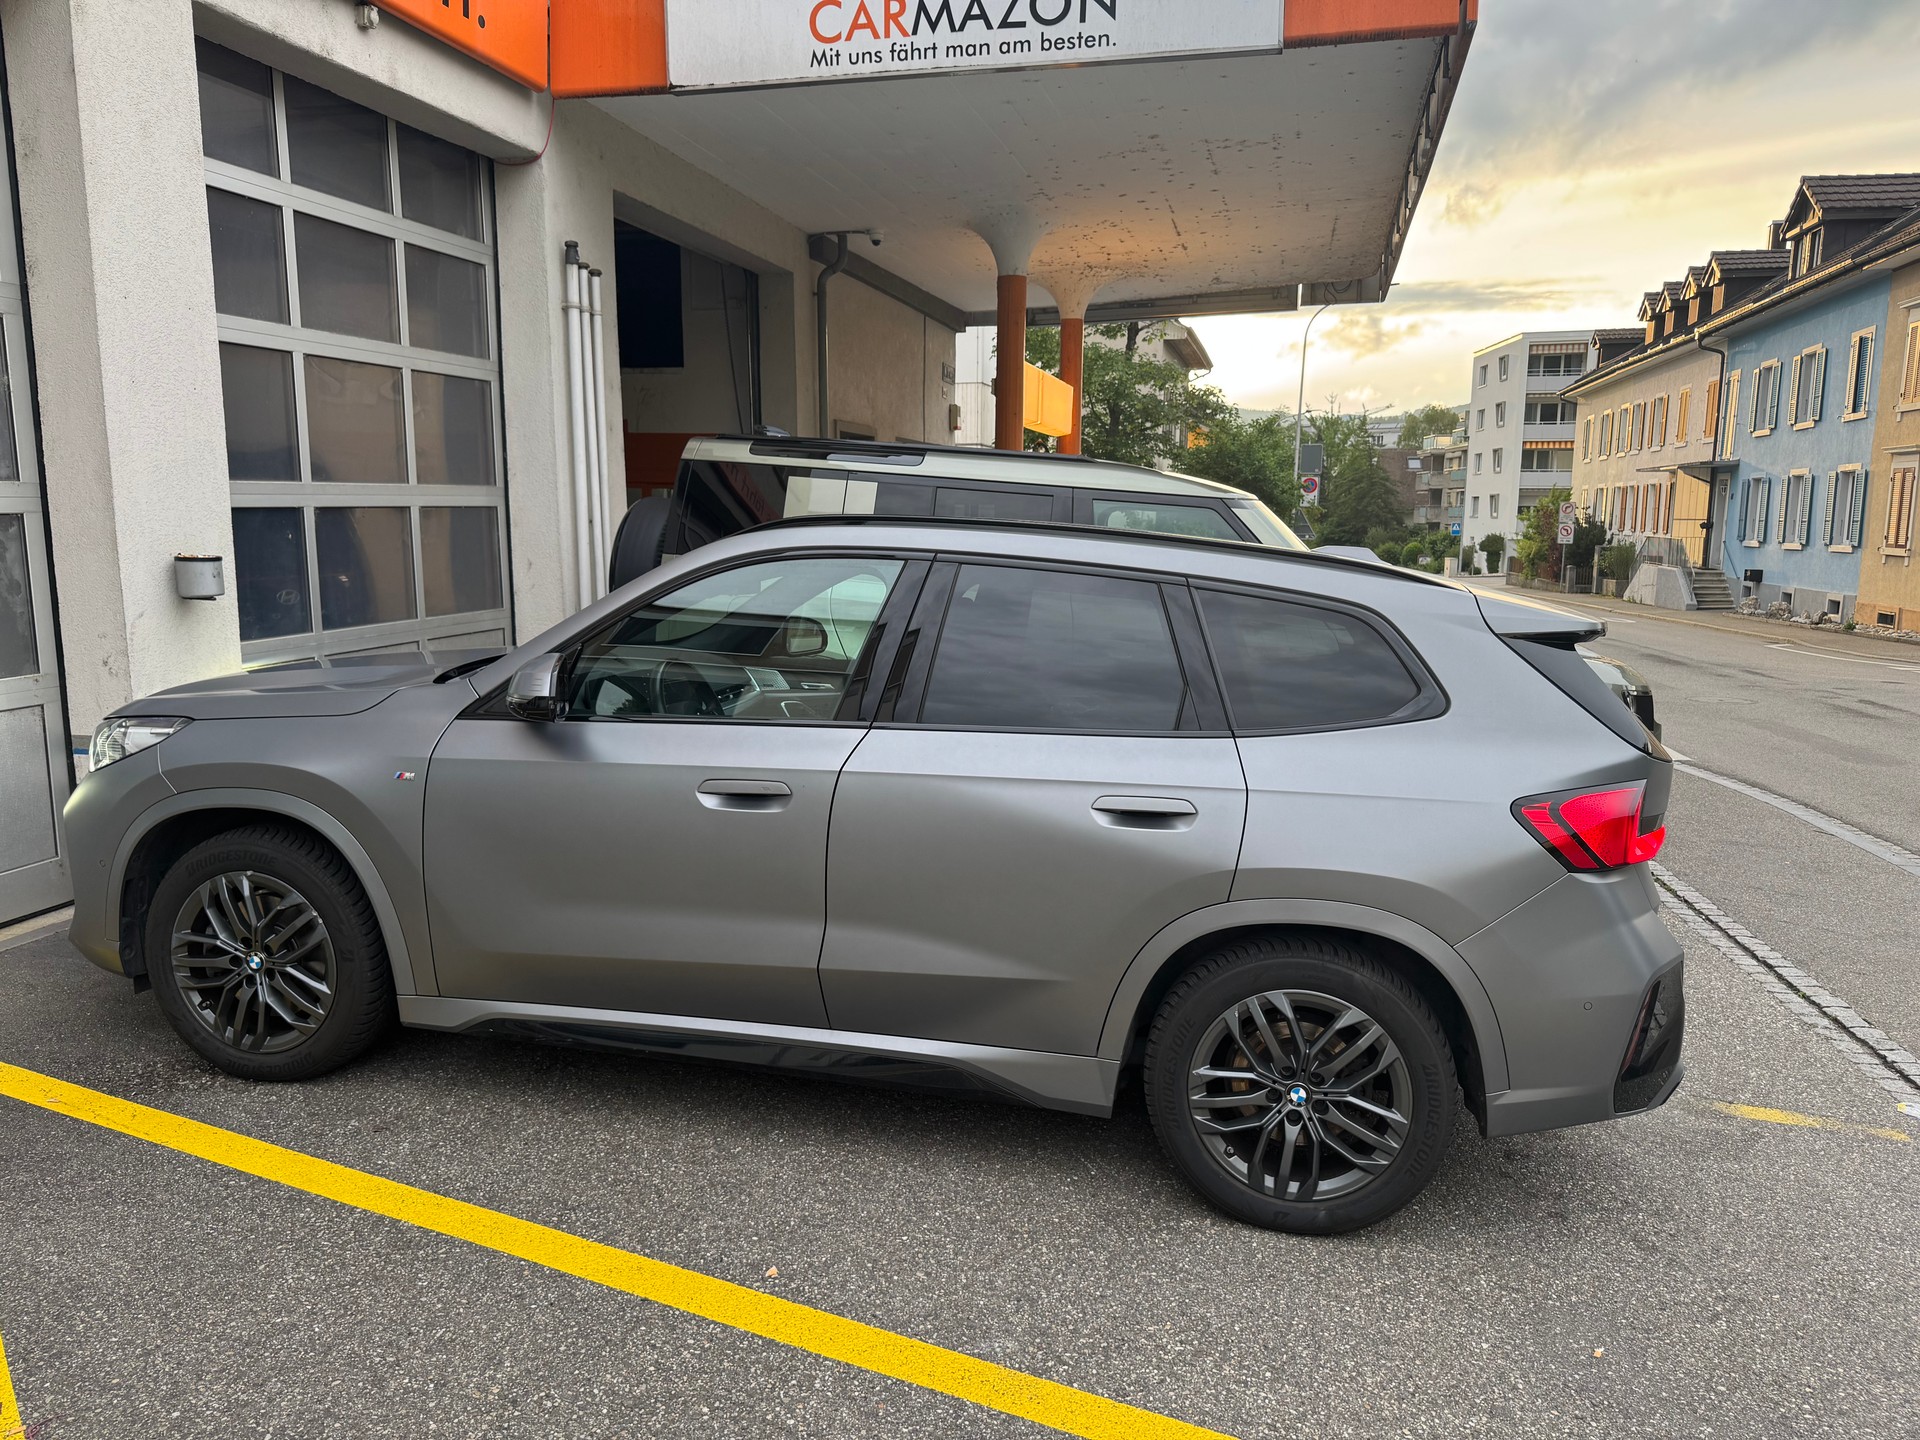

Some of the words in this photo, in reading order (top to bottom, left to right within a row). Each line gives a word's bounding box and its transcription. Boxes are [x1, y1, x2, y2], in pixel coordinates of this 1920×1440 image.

[810, 48, 841, 68] Mit
[848, 50, 883, 66] uns
[889, 42, 938, 62] fährt
[945, 42, 991, 59] man
[998, 39, 1031, 55] am
[1040, 31, 1117, 52] besten.
[185, 850, 278, 877] BRIDGESTONE
[1404, 1063, 1441, 1182] BRIDGESTONE
